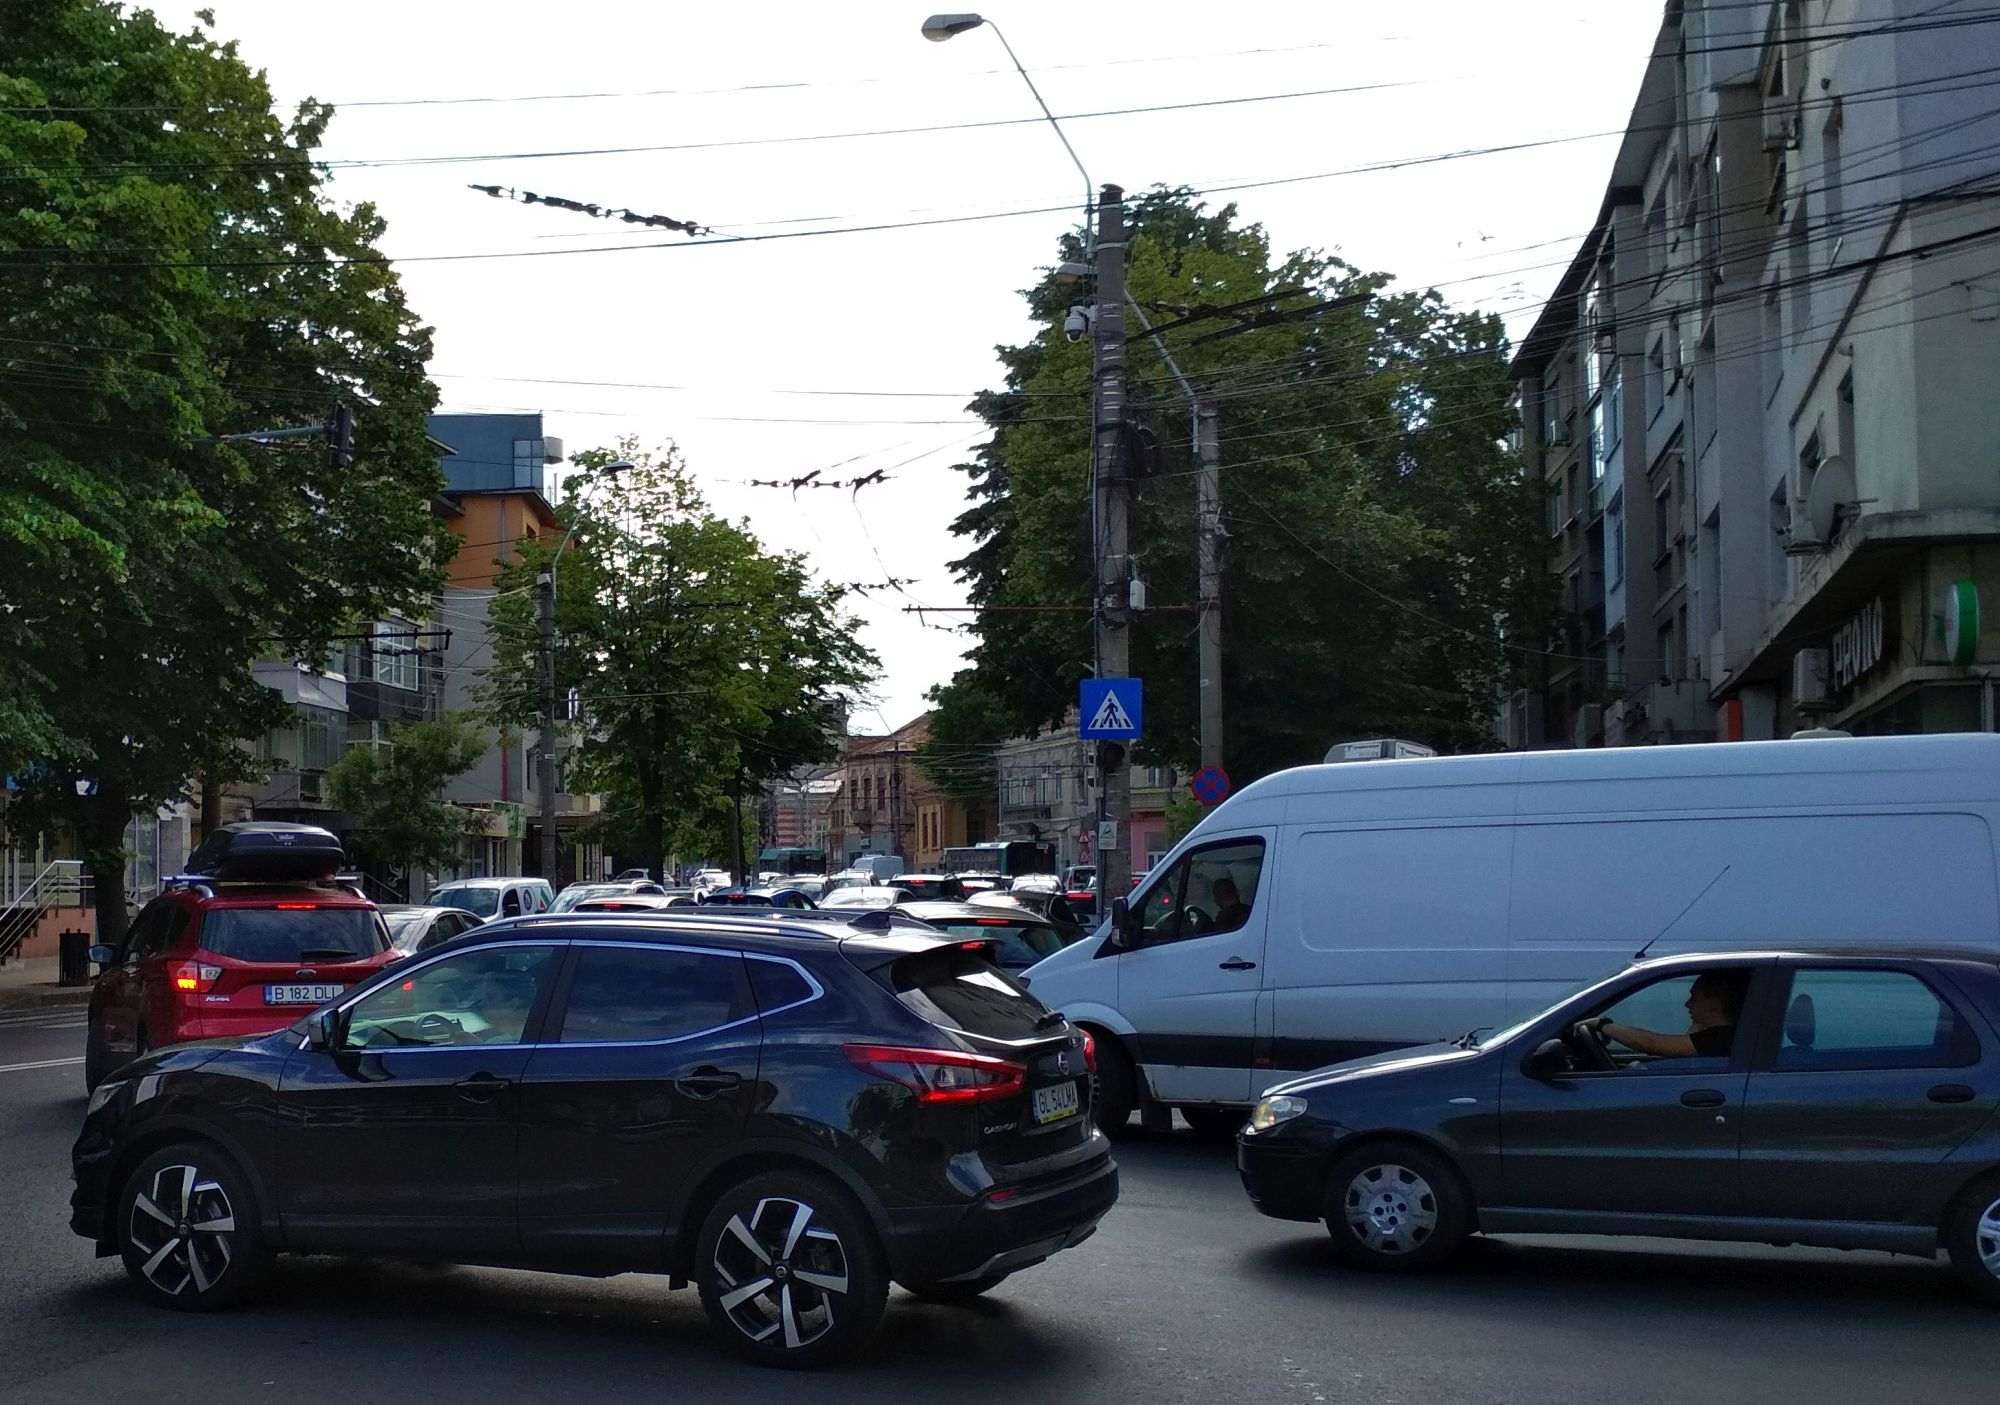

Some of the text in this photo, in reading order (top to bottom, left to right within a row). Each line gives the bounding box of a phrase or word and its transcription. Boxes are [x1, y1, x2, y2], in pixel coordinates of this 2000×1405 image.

[275, 987, 284, 1000] B
[289, 987, 310, 1000] 182
[1039, 1090, 1051, 1114] GL
